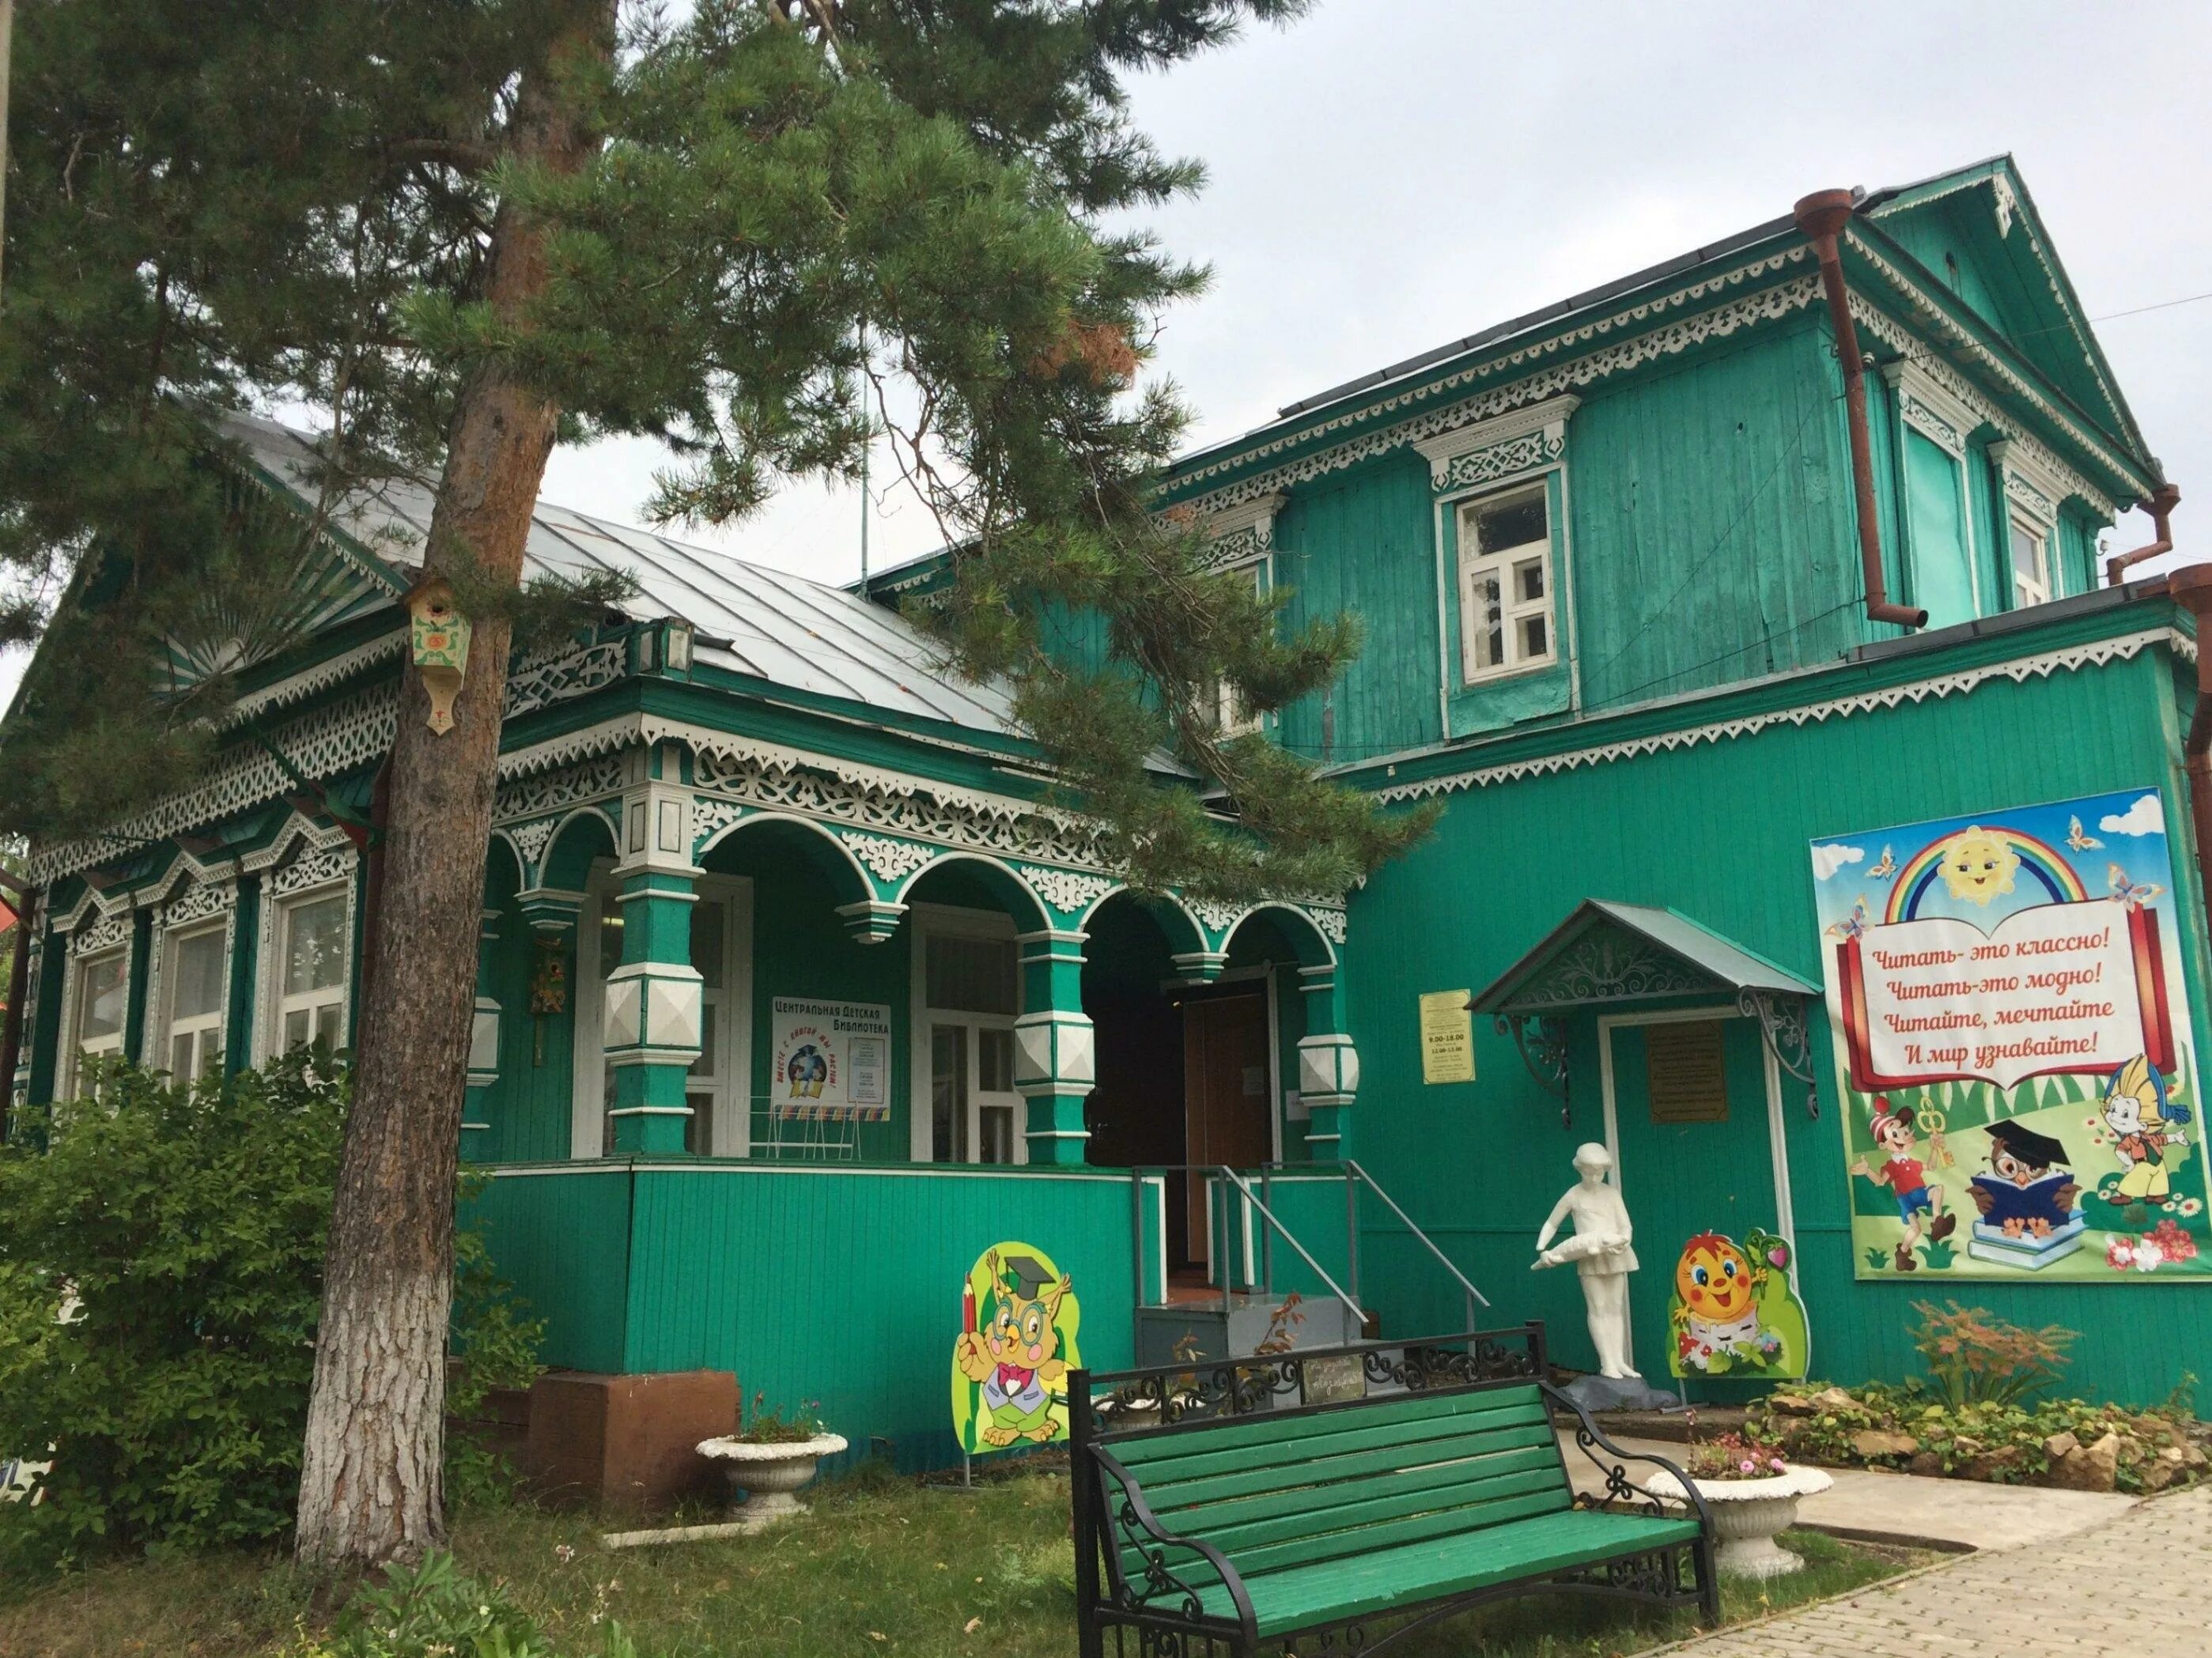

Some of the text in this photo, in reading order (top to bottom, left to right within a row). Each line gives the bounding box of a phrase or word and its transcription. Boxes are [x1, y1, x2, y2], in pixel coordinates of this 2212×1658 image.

[1872, 926, 2110, 969] Читать- это классно!
[1886, 961, 2102, 1001] Читать-это модно!
[1884, 999, 2116, 1033] Читайте, мечтайте
[1904, 1031, 2098, 1071] И мир узнавайте!
